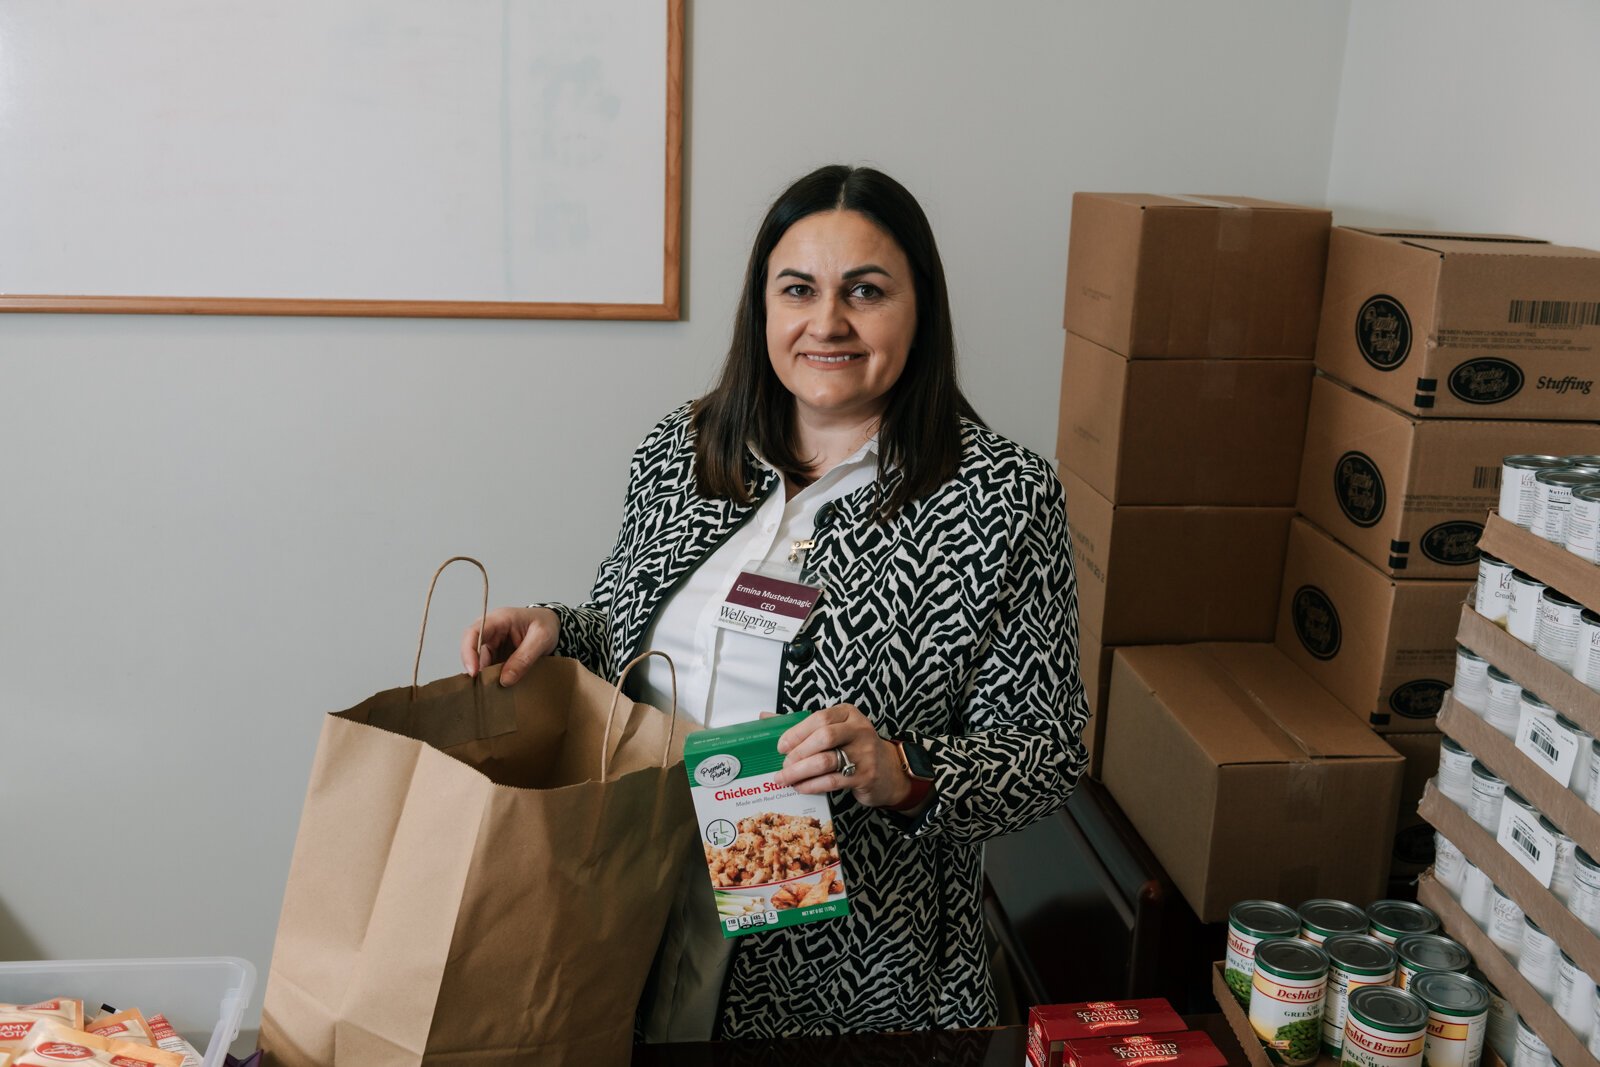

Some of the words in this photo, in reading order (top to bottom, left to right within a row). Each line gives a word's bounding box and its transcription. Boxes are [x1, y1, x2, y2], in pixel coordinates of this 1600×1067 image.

[1536, 376, 1594, 394] Stuffing
[736, 584, 761, 596] Ermina
[761, 590, 812, 608] Mustedanagic
[760, 602, 776, 612] CEO
[720, 605, 777, 635] Wellspring
[700, 761, 725, 777] Premier
[709, 766, 732, 781] Pantry
[714, 786, 761, 802] Chicken
[775, 792, 797, 800] Chicken
[713, 831, 719, 846] 5
[1277, 989, 1319, 1000] Deshler
[1076, 1009, 1139, 1018] SCALLOPED
[1083, 1014, 1139, 1023] POTATOES
[1112, 1043, 1177, 1053] SCALLOPED
[1373, 1040, 1410, 1054] Brand
[1120, 1049, 1178, 1059] POTATOES
[1360, 1052, 1375, 1061] Cut
